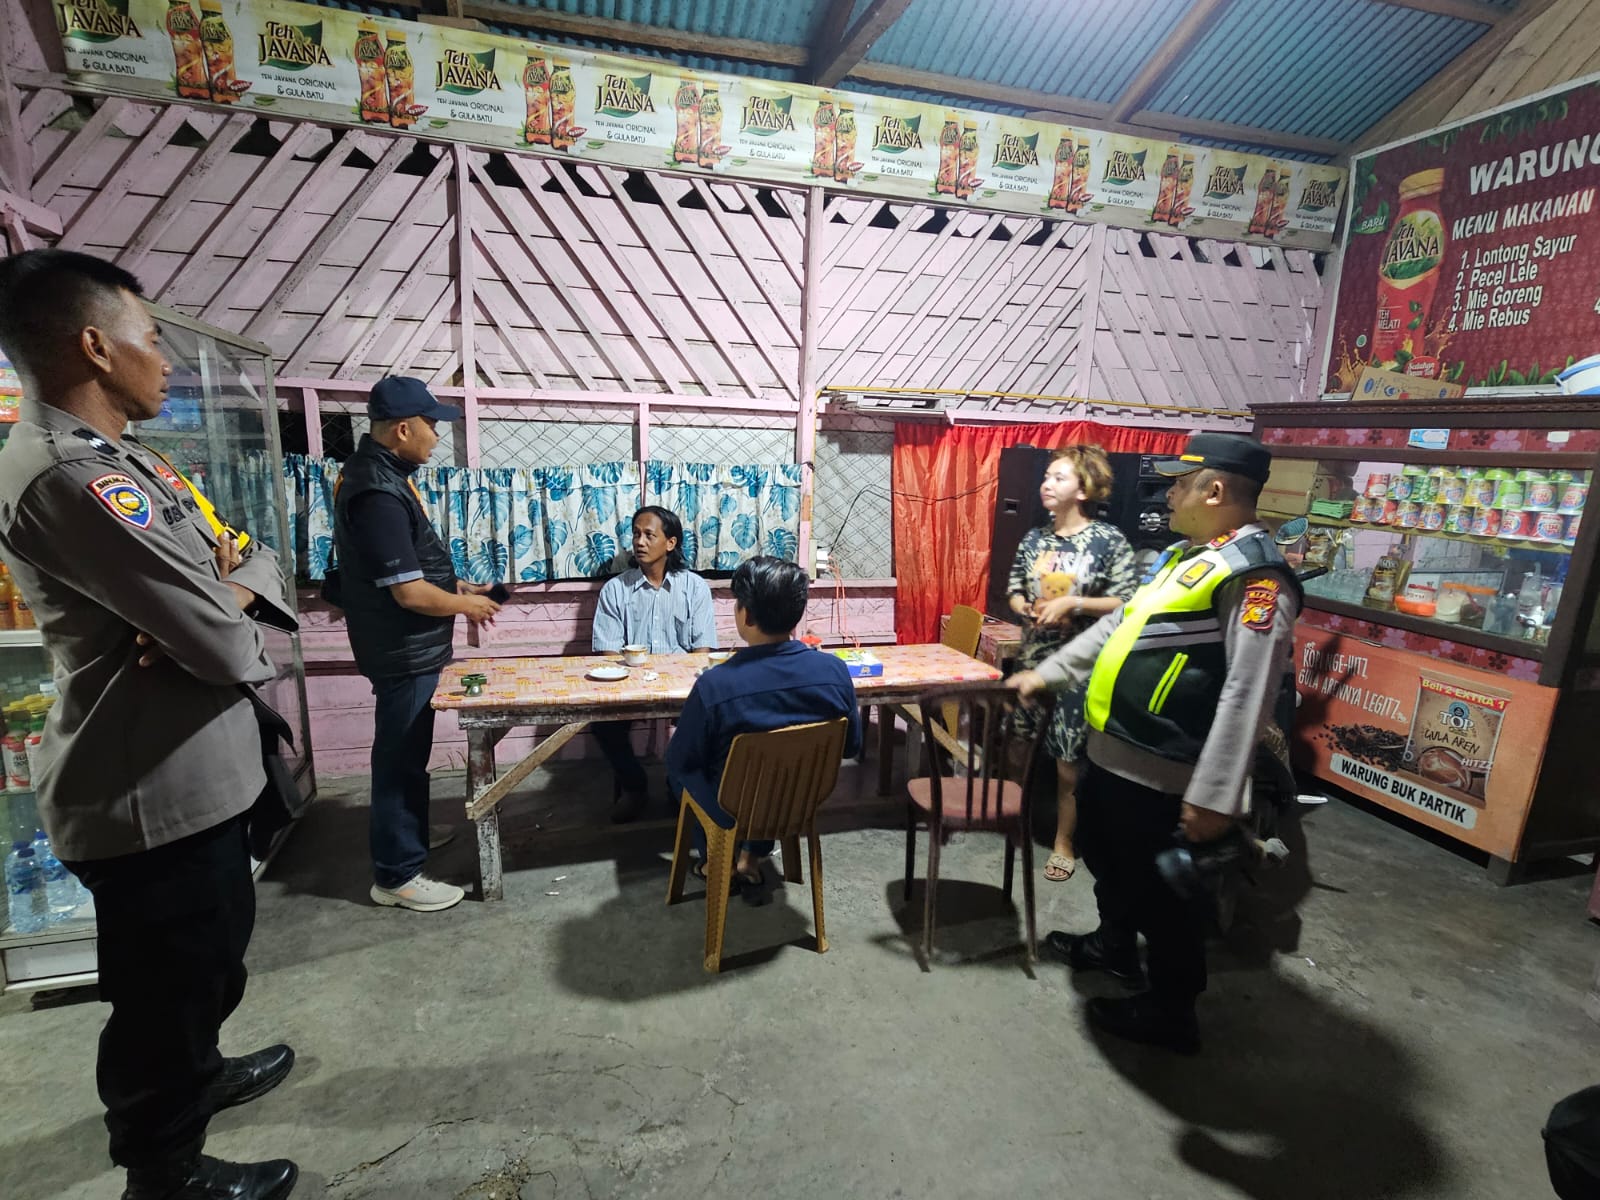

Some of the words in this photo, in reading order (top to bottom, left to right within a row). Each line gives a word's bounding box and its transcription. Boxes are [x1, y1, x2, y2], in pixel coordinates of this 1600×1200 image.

[59, 2, 144, 38] JAVANA
[266, 21, 294, 39] Teh
[106, 50, 149, 64] ORIGINAL
[258, 34, 333, 66] JAVANA
[444, 49, 469, 66] Teh
[82, 59, 91, 69] &
[298, 77, 337, 91] ORIGINAL
[435, 61, 503, 91] JAVANA
[605, 74, 627, 90] Teh
[277, 85, 284, 95] &
[595, 86, 656, 113] JAVANA
[470, 102, 505, 114] ORIGINAL
[750, 96, 770, 110] Teh
[450, 108, 457, 118] &
[740, 106, 796, 131] JAVANA
[882, 115, 901, 129] Teh
[606, 131, 613, 139] &
[625, 124, 657, 135] ORIGINAL
[873, 125, 923, 149] JAVANA
[1003, 133, 1019, 147] Teh
[896, 159, 923, 169] ORIGINAL
[992, 143, 1040, 167] JAVANA
[1113, 150, 1129, 162] Teh
[1103, 160, 1146, 182] JAVANA
[1204, 175, 1245, 196] JAVANA
[1298, 188, 1337, 208] JAVANA
[1361, 216, 1386, 230] BARU
[1452, 210, 1499, 241] MENU
[1503, 188, 1596, 230] MAKANAN
[1398, 223, 1415, 239] Teh
[1382, 236, 1440, 270] JAVANA
[1460, 250, 1471, 270] 1.
[1474, 243, 1530, 268] Lontong
[1532, 234, 1578, 261] Sayur
[1455, 271, 1466, 291] 2.
[1469, 263, 1508, 289] Pecel
[1509, 259, 1538, 284] Lele
[1452, 292, 1462, 312] 3.
[1466, 288, 1489, 310] Mie
[1492, 285, 1543, 308] Goreng
[1379, 309, 1390, 319] TEH
[1448, 313, 1458, 333] 4.
[1462, 309, 1485, 331] Mie
[1487, 306, 1531, 328] Rebus
[1298, 668, 1320, 691] GULA
[1362, 689, 1401, 720] LEGITZ
[1422, 679, 1443, 692] Beli
[1446, 686, 1453, 695] 2
[1454, 688, 1494, 705] EXTRA
[1498, 700, 1505, 710] 1
[1440, 711, 1474, 730] TOP
[1425, 729, 1449, 743] GULA
[1451, 736, 1481, 755] AREN
[1341, 758, 1389, 790] WARUNG
[1390, 779, 1416, 803] BUK
[1419, 791, 1468, 823] PARTIK
